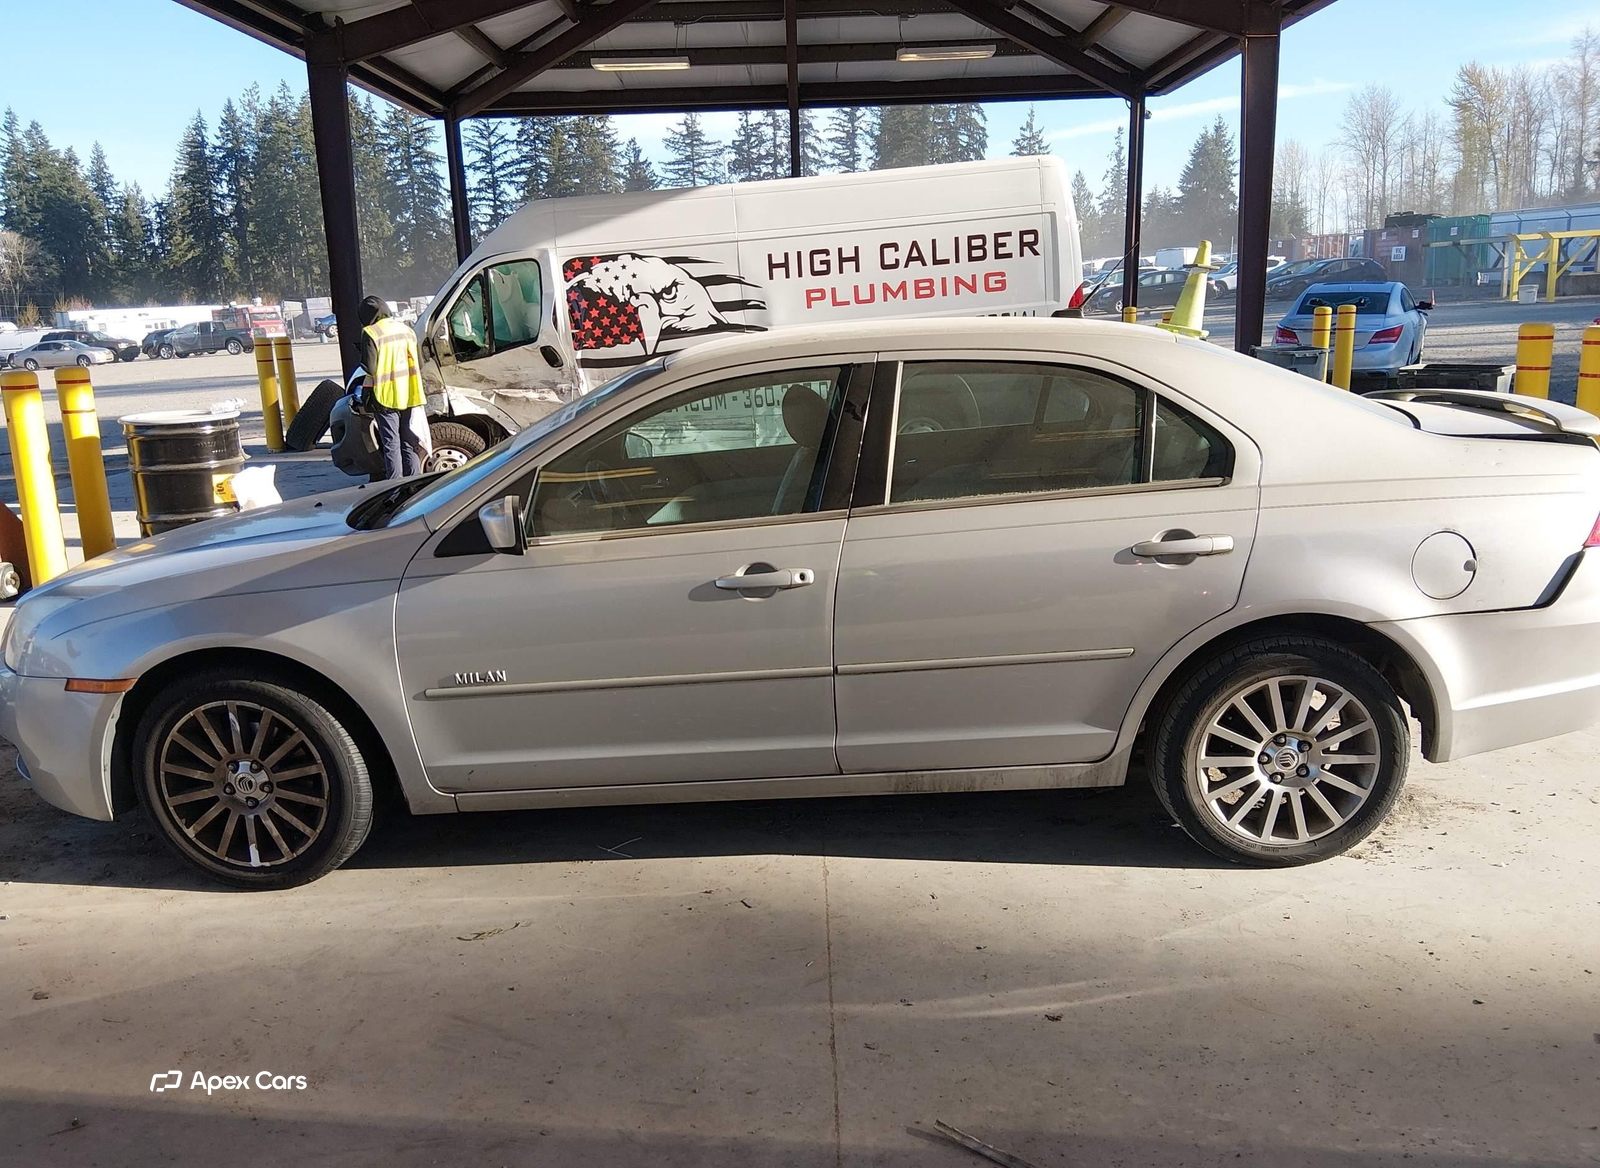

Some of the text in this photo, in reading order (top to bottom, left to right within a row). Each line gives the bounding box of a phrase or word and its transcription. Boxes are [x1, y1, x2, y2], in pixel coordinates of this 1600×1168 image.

[767, 228, 1041, 281] HIGH CALIBER
[805, 271, 1008, 309] PLUMBING
[454, 669, 507, 685] MILAN
